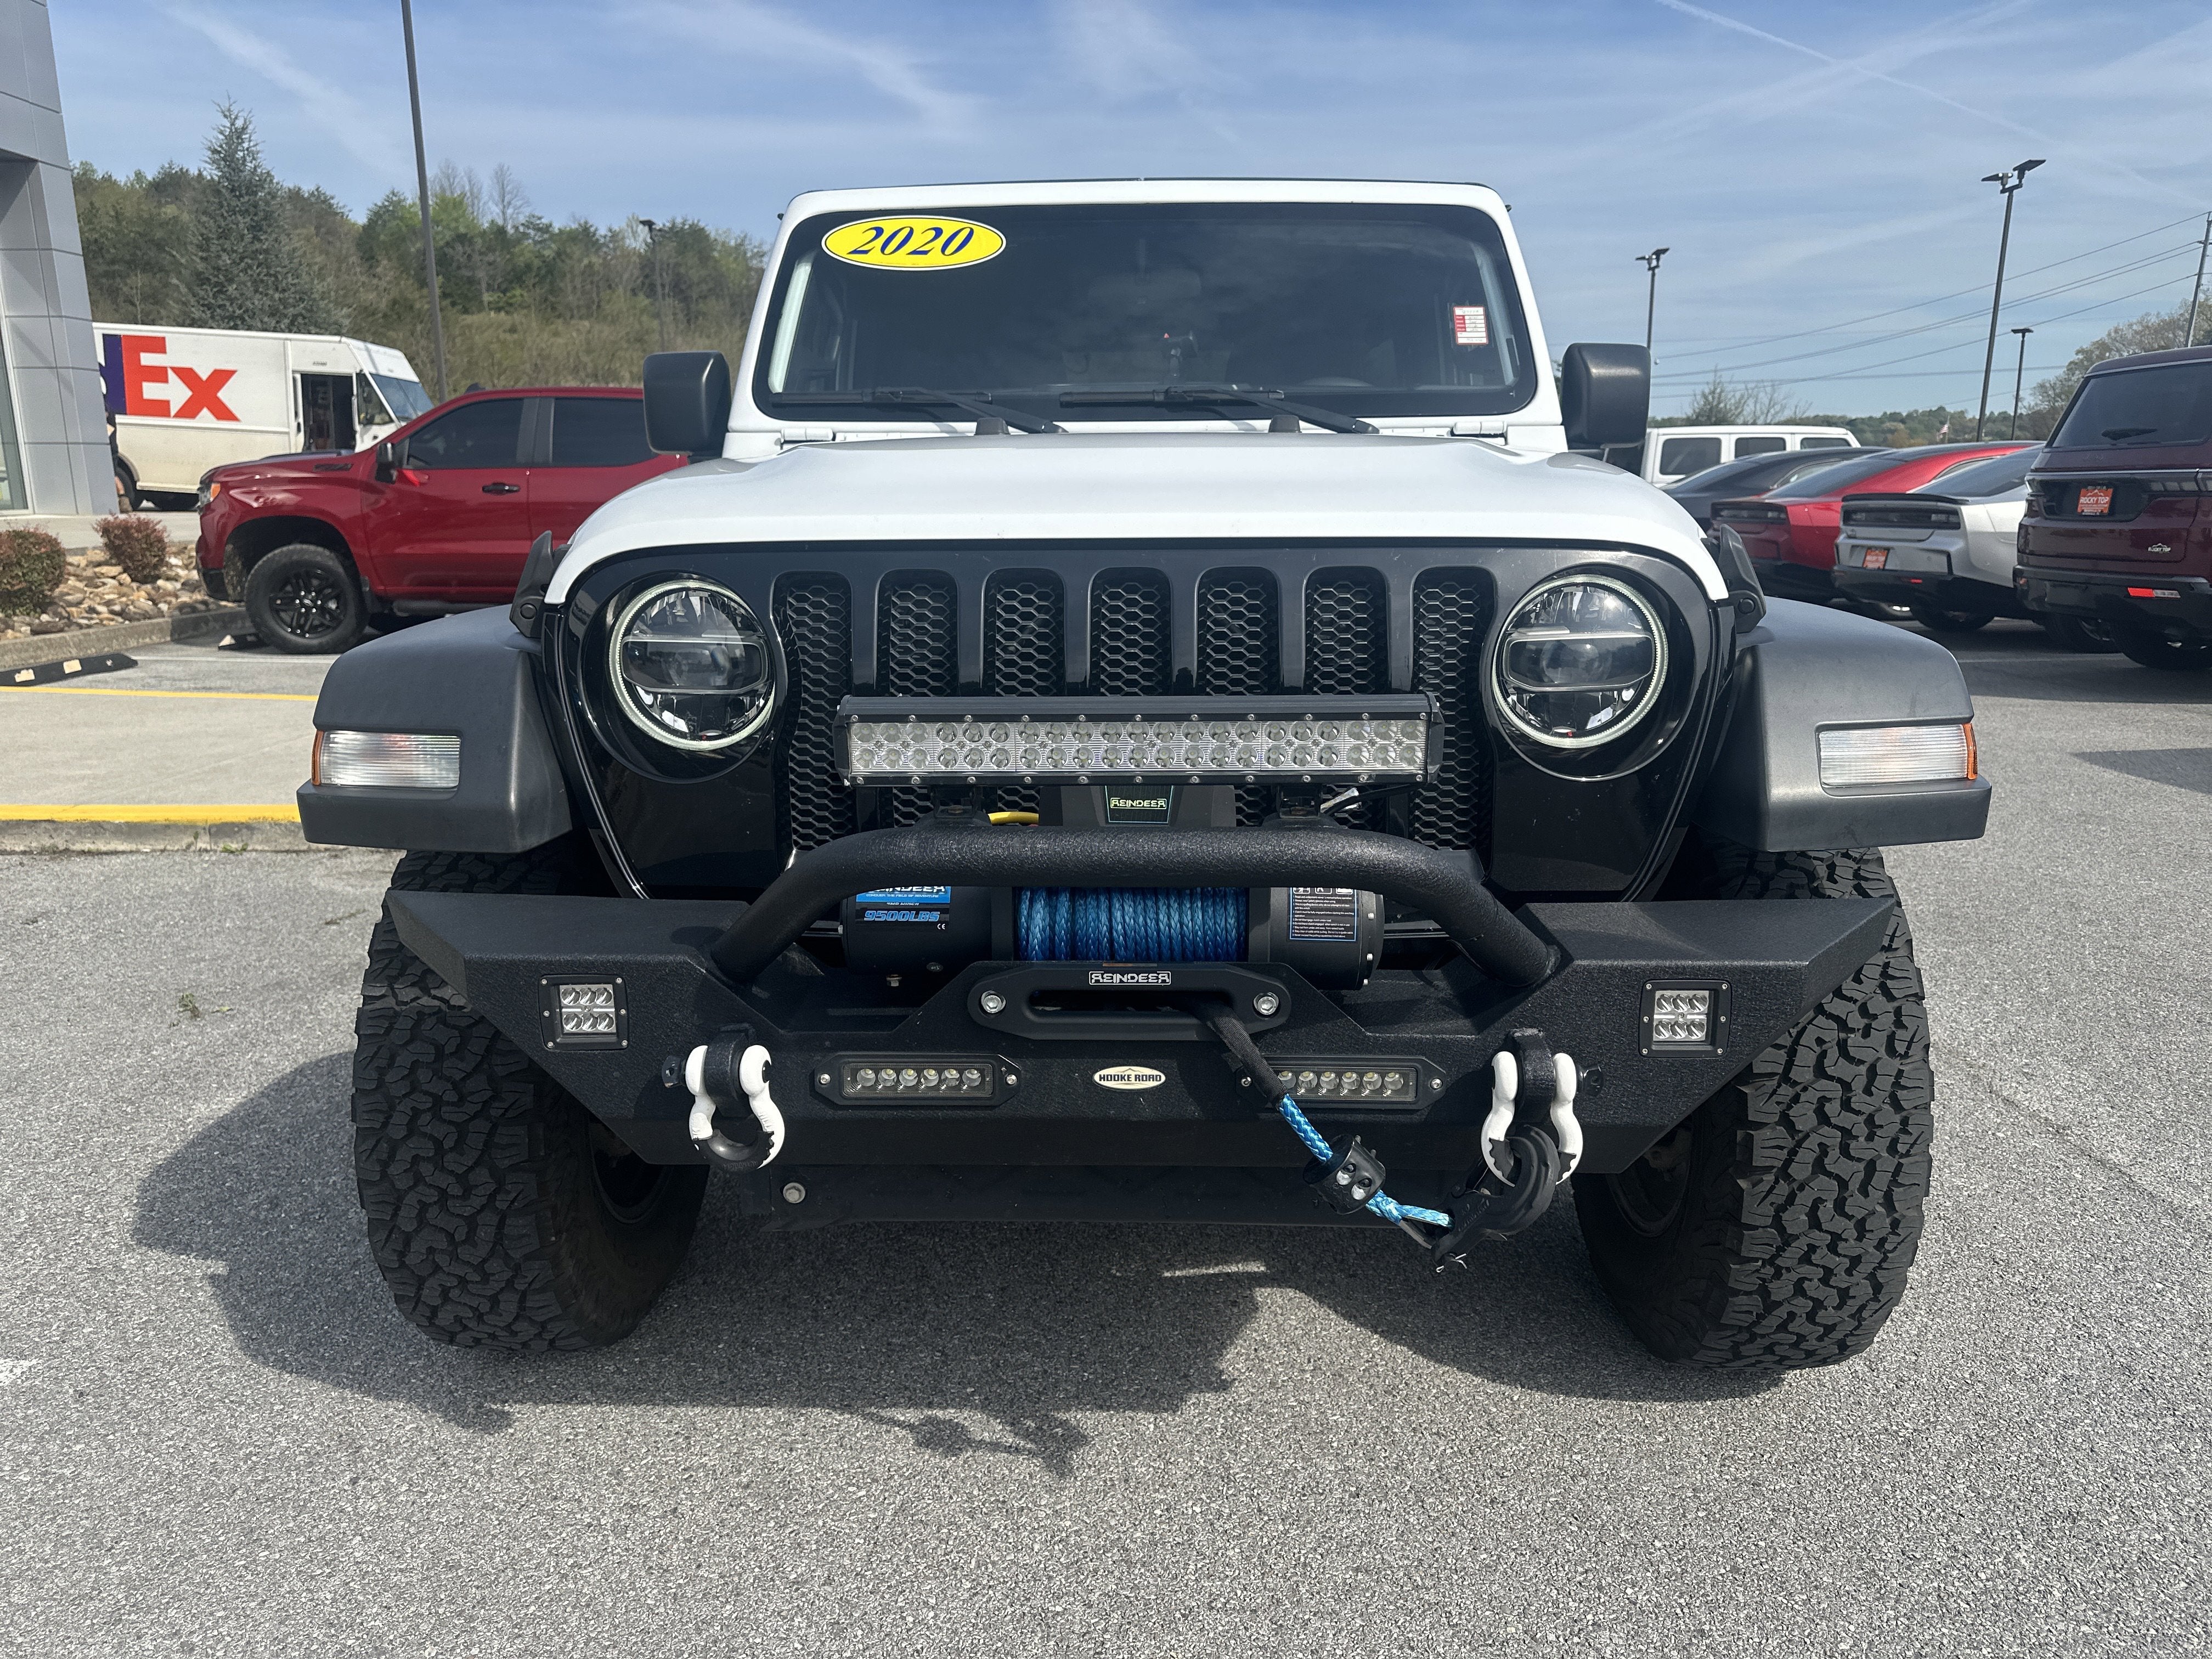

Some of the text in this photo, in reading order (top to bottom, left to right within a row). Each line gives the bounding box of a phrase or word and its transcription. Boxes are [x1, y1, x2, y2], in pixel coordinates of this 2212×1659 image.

[847, 226, 974, 256] 2020
[1111, 799, 1166, 808] REINDEER
[864, 910, 940, 922] 9500LBS
[1091, 973, 1170, 984] REINDEER
